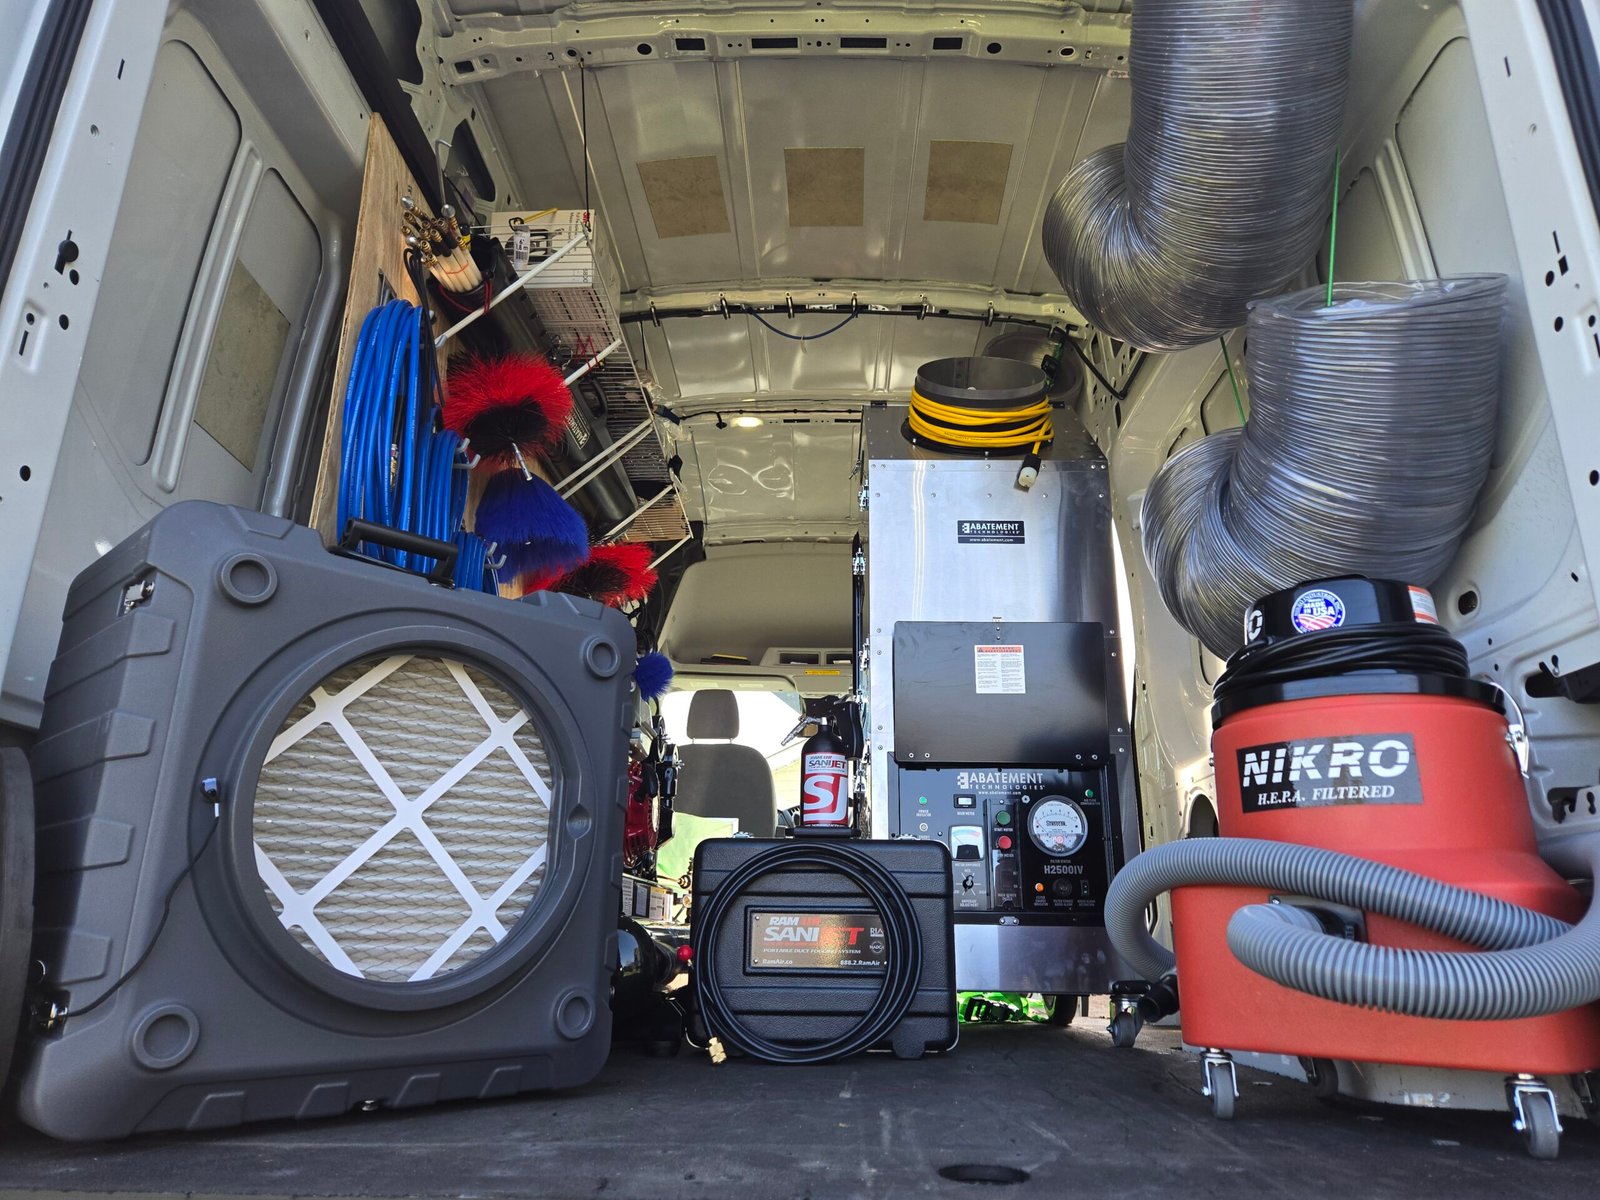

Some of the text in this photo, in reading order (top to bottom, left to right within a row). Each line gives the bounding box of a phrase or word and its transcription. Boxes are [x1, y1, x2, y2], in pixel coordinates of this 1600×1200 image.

[970, 523, 1019, 531] ABATEMENT
[1304, 601, 1326, 609] MADE
[1313, 605, 1336, 616] USA
[808, 760, 846, 769] SANIJET
[1242, 739, 1410, 788] NIKRO
[969, 772, 1043, 784] ABATEMENT
[1257, 785, 1395, 806] H.E.P.A. FILTERED
[1043, 865, 1084, 875] H2500IV
[769, 916, 800, 926] RAM
